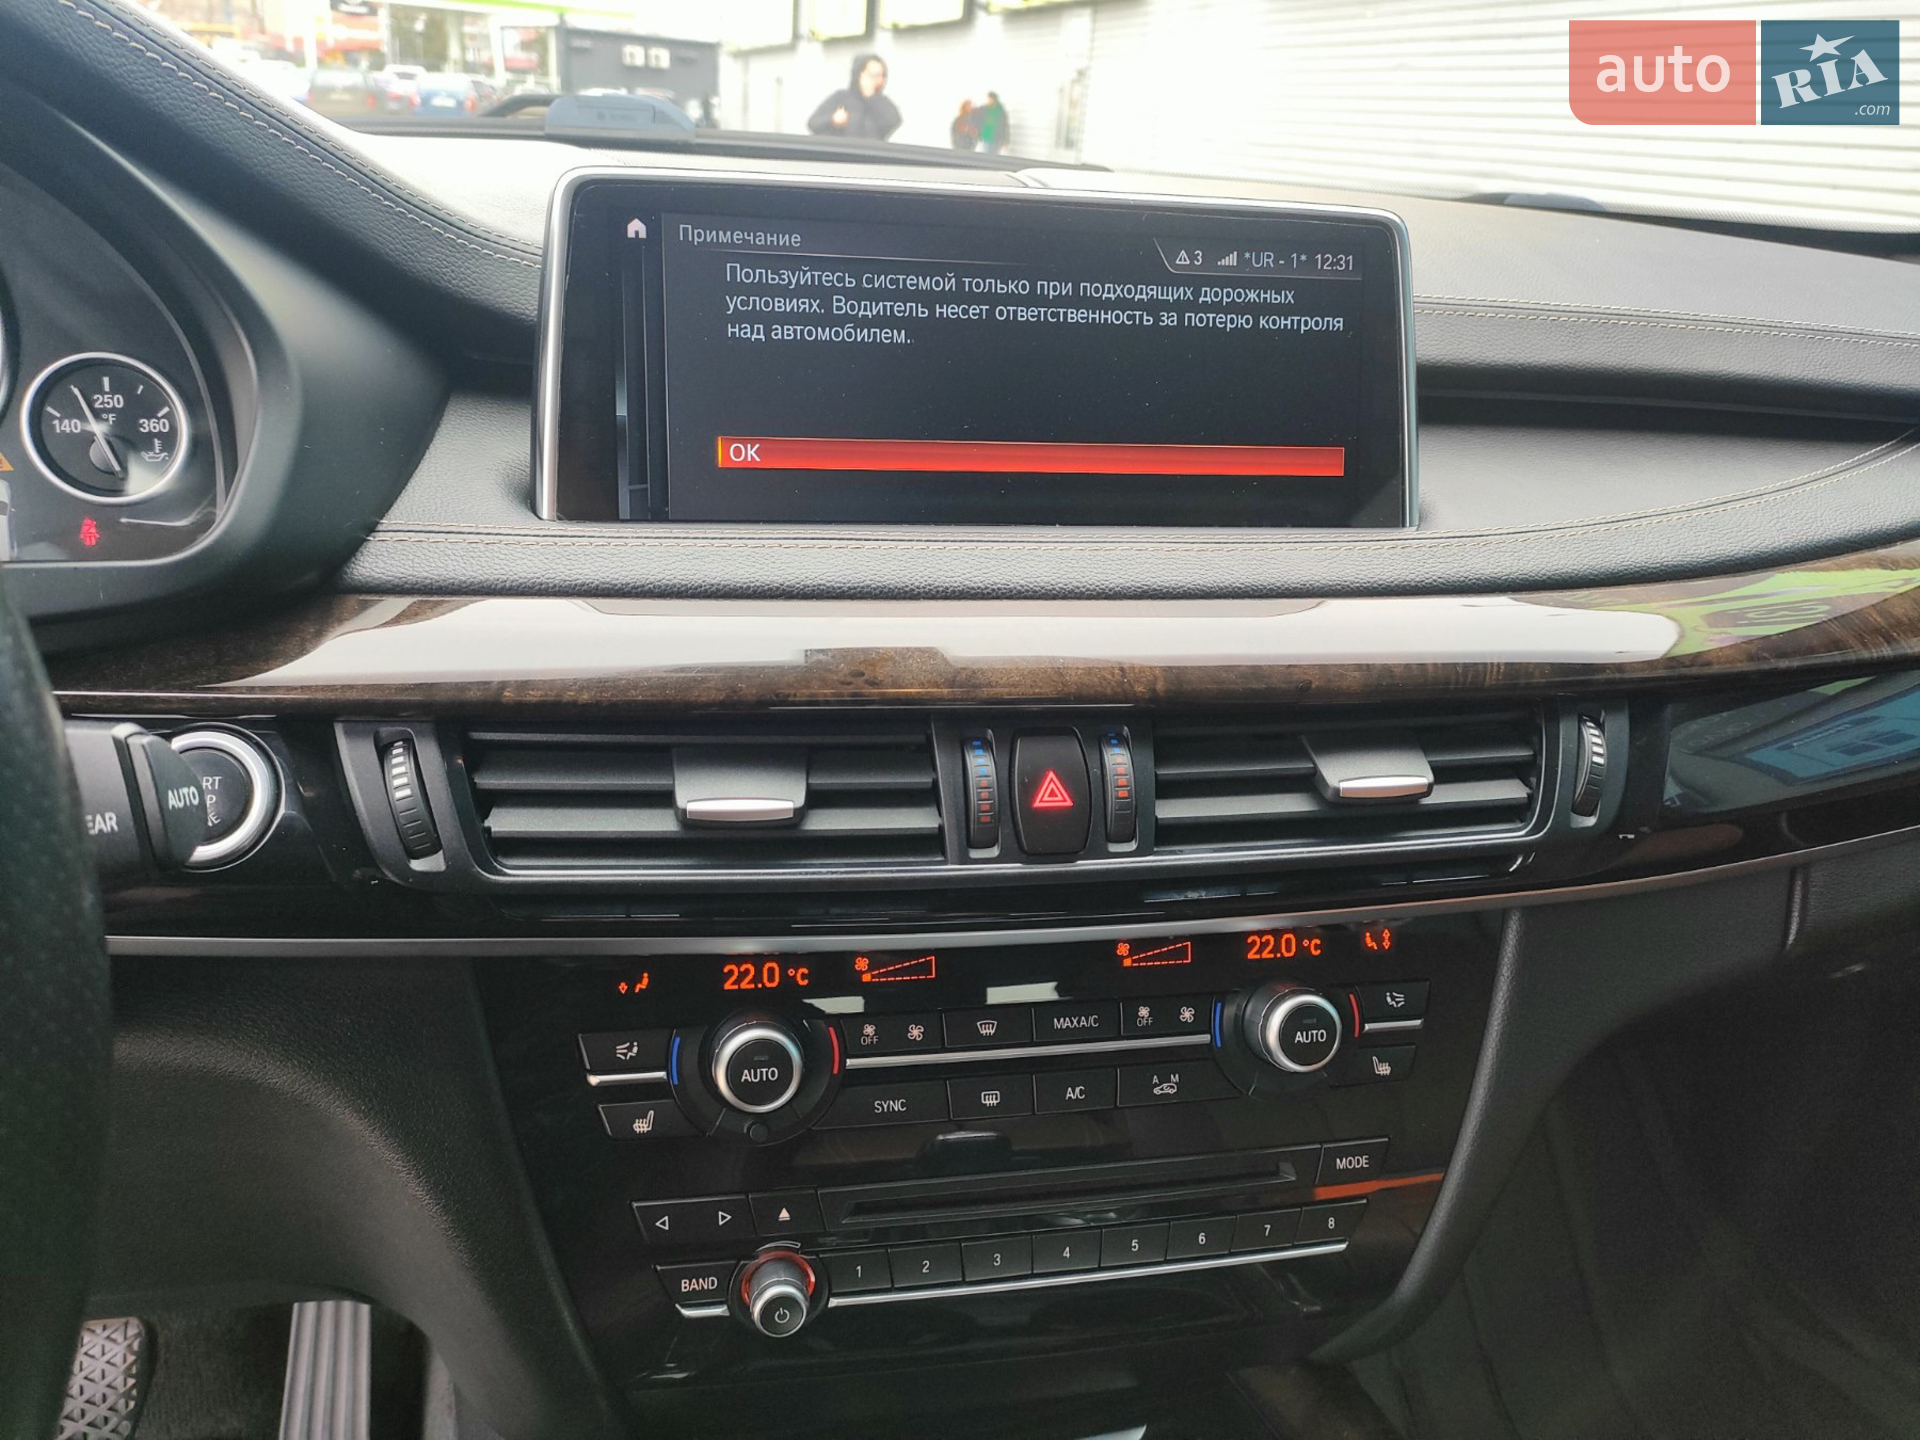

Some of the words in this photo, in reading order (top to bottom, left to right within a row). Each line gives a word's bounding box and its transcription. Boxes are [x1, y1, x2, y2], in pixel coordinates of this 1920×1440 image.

[679, 224, 801, 247] Примечание
[1193, 250, 1203, 266] 3
[1314, 253, 1353, 271] 12:31
[726, 262, 856, 289] Пользуйтесь
[862, 272, 956, 292] системой
[961, 277, 1030, 295] только
[1037, 280, 1073, 300] при
[1080, 282, 1194, 303] подходящих
[1198, 287, 1295, 306] дорожных
[725, 295, 825, 315] условиях.
[832, 295, 929, 319] Водитель
[935, 303, 990, 320] несет
[995, 305, 1154, 326] ответственность
[1158, 311, 1178, 326] за
[1184, 312, 1253, 332] потерю
[1259, 315, 1344, 334] контроля
[727, 323, 766, 342] над
[771, 323, 911, 344] автомобилем.
[93, 394, 124, 409] 250
[52, 418, 82, 433] 140
[102, 413, 117, 426] °F
[139, 418, 170, 433] 360
[729, 443, 761, 462] OK
[167, 785, 200, 810] AUTO
[1247, 933, 1296, 960] 22.0
[1302, 938, 1322, 956] °C
[723, 961, 780, 991] 22.0
[787, 967, 809, 986] °C
[1135, 1016, 1155, 1028] OFF
[859, 1034, 880, 1046] OFF
[1294, 1029, 1327, 1044] AUTO
[740, 1067, 779, 1083] AUTO
[1152, 1074, 1160, 1085] A
[1169, 1073, 1180, 1084] M
[1065, 1085, 1086, 1100] A/C
[874, 1098, 907, 1113] SYNC
[1336, 1155, 1370, 1170] MODE
[1264, 1224, 1271, 1237] 7
[1327, 1216, 1335, 1230] 8
[1131, 1239, 1139, 1252] 5
[1198, 1232, 1206, 1245] 6
[993, 1253, 1001, 1266] 3
[1062, 1246, 1071, 1259] 4
[856, 1265, 862, 1278] 1
[922, 1260, 930, 1273] 2
[681, 1276, 718, 1292] BAND
